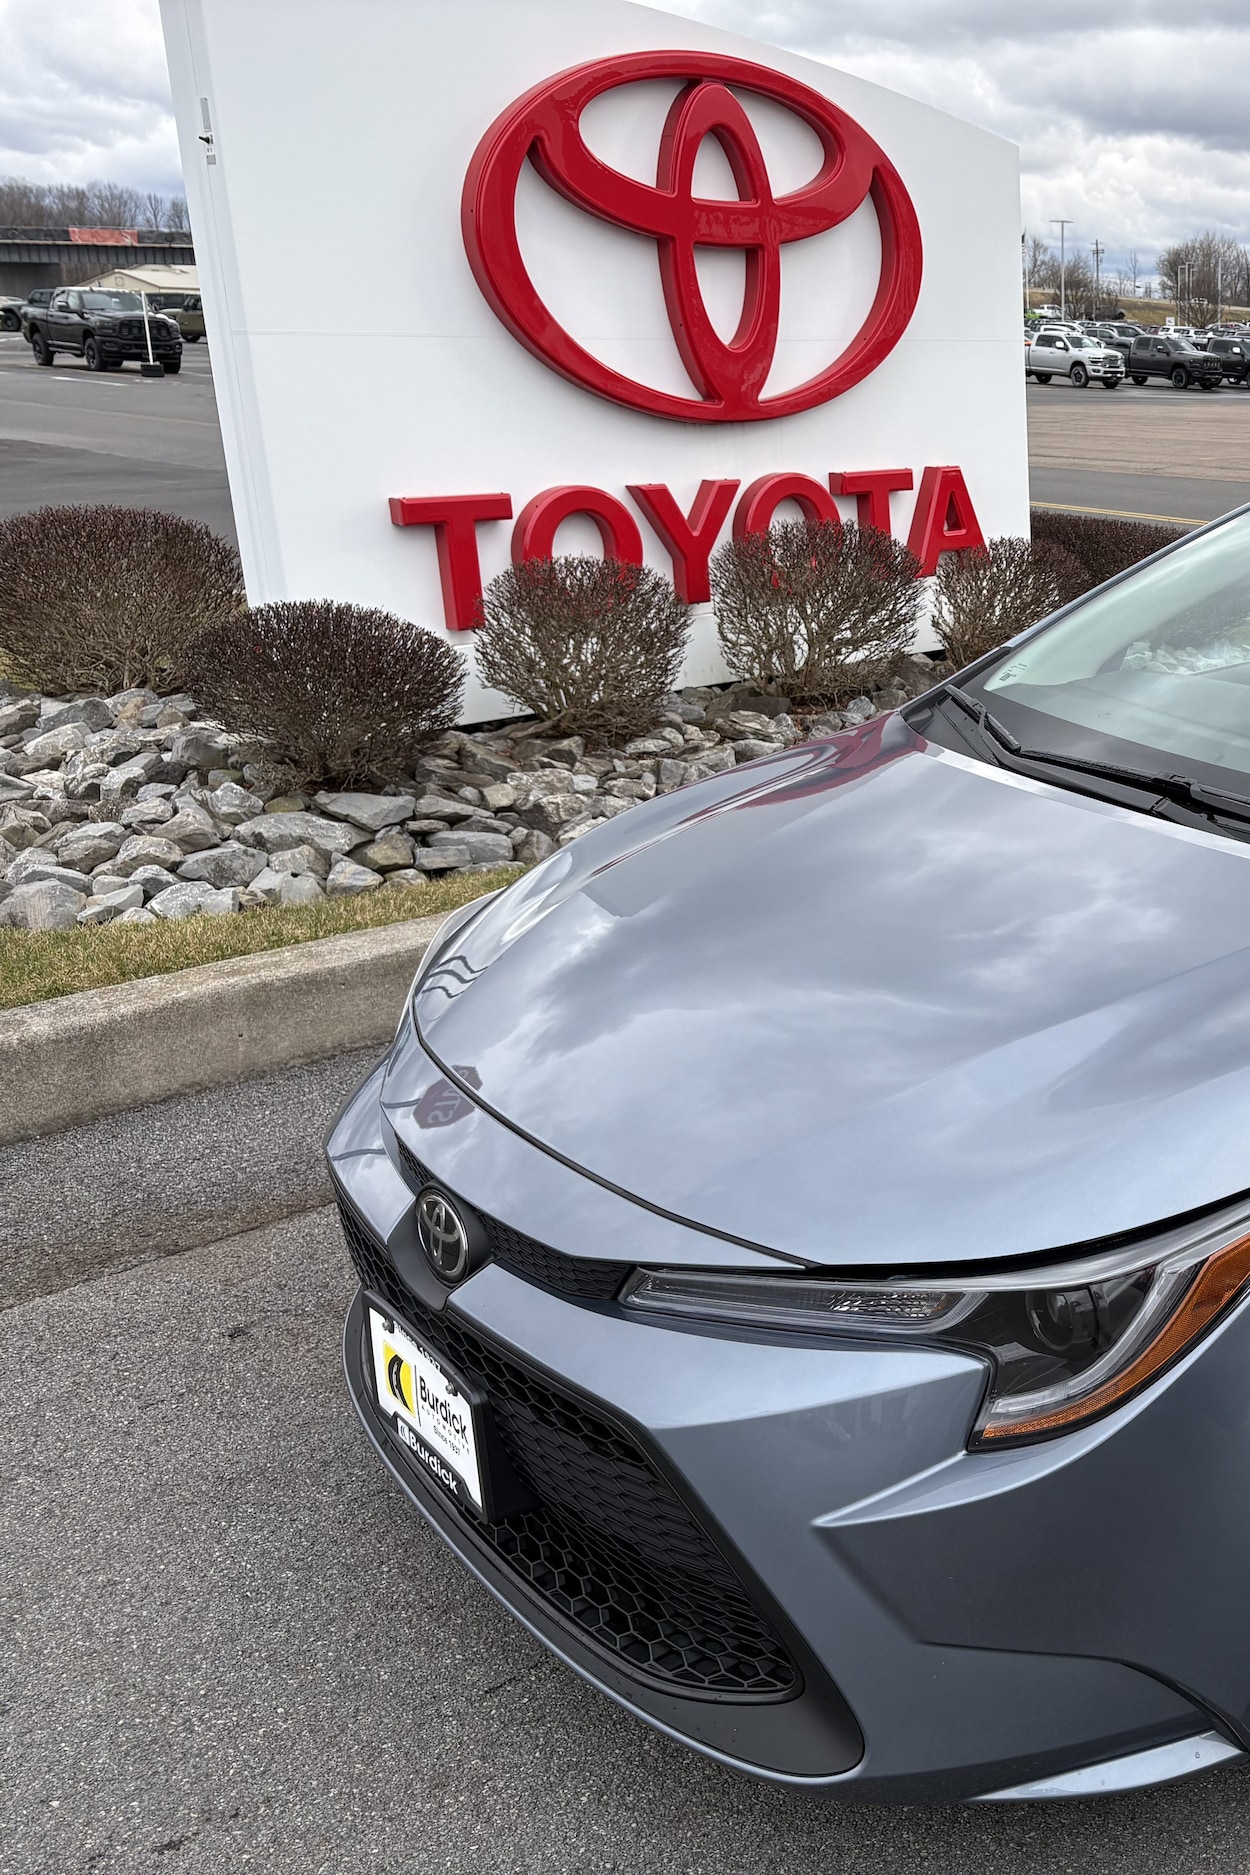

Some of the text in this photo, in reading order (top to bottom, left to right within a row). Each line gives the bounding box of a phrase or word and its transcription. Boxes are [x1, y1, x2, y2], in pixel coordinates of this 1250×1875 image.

[419, 1375, 468, 1445] Burdick
[421, 1404, 471, 1456] AUTOMOTIVE
[409, 1430, 458, 1495] Burdick
